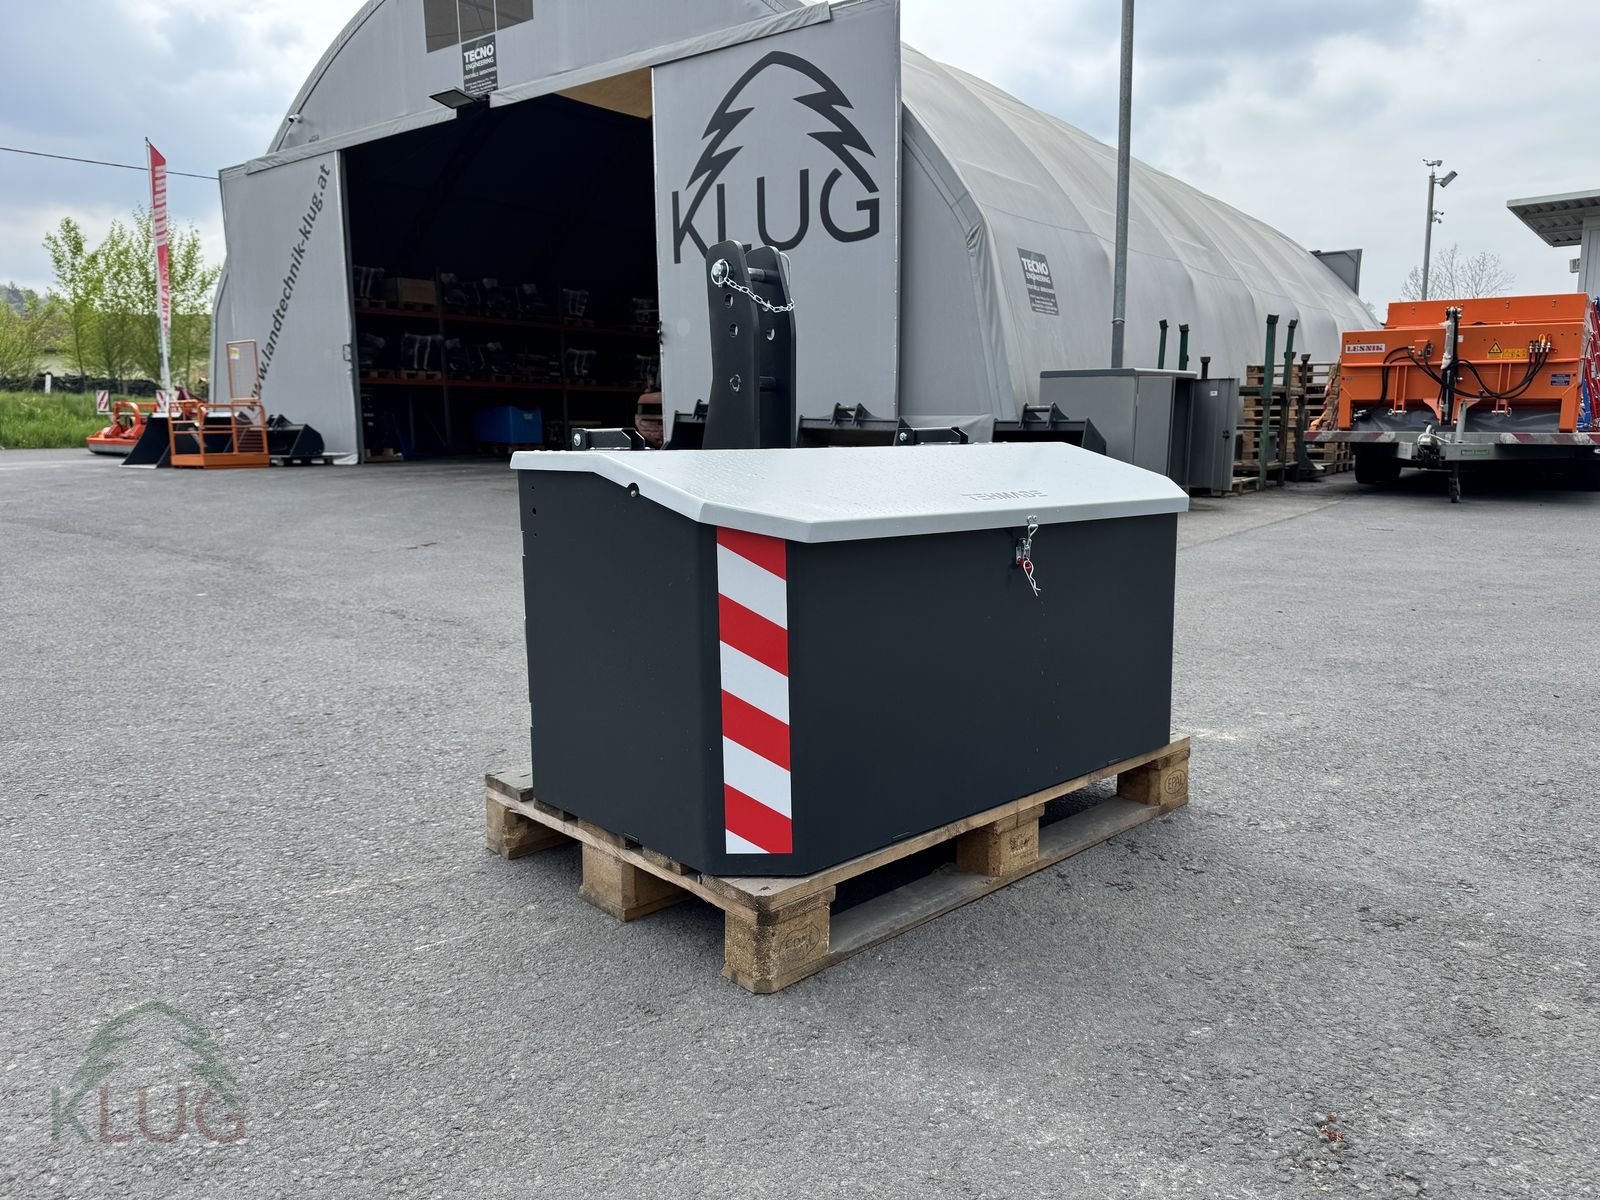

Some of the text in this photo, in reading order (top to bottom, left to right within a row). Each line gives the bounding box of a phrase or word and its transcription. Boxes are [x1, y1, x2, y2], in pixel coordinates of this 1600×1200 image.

[464, 45, 494, 63] TECNO
[671, 167, 880, 265] KLUG
[1021, 257, 1049, 275] TECNO
